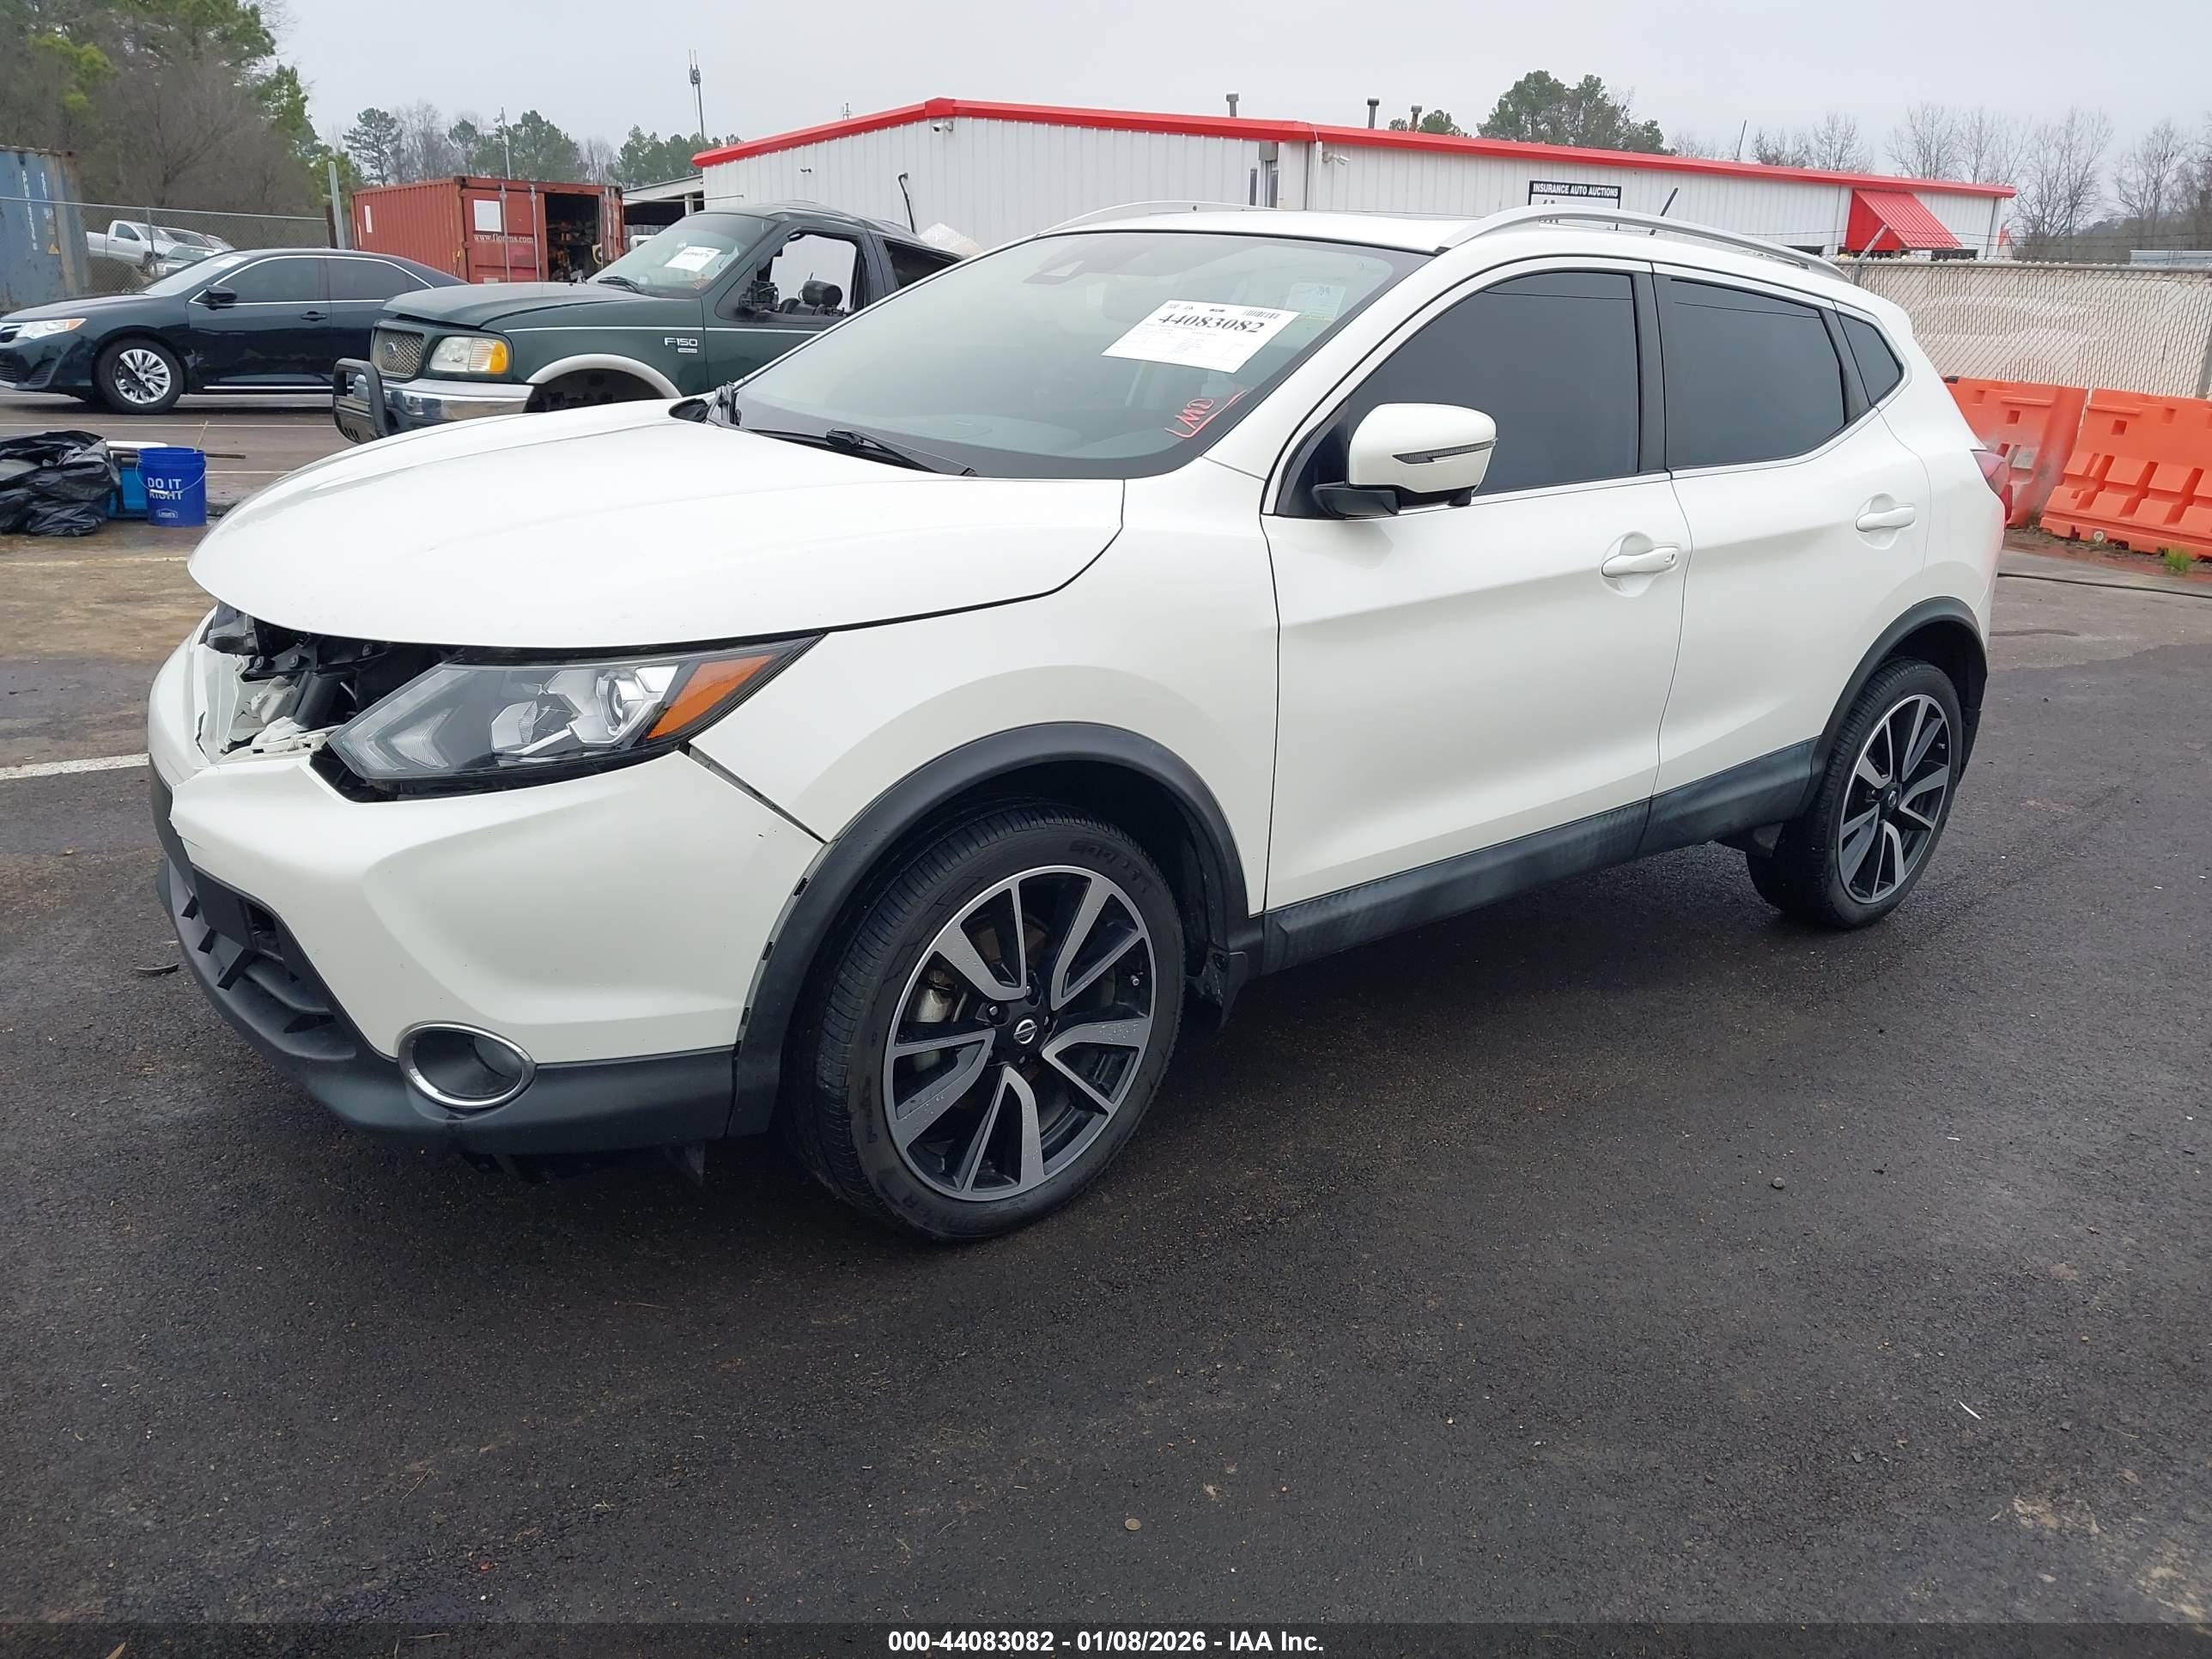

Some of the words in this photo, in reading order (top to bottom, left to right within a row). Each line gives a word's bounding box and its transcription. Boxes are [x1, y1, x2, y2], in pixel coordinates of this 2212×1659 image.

[1533, 183, 1569, 194] INSURANCE
[1570, 185, 1587, 195] AUTO
[1588, 187, 1619, 198] AUCTIONS
[474, 233, 533, 244] www.florns.com
[1158, 313, 1265, 333] 44083082
[147, 477, 164, 489] DO
[168, 479, 182, 489] IT
[149, 489, 183, 500] RIGHT
